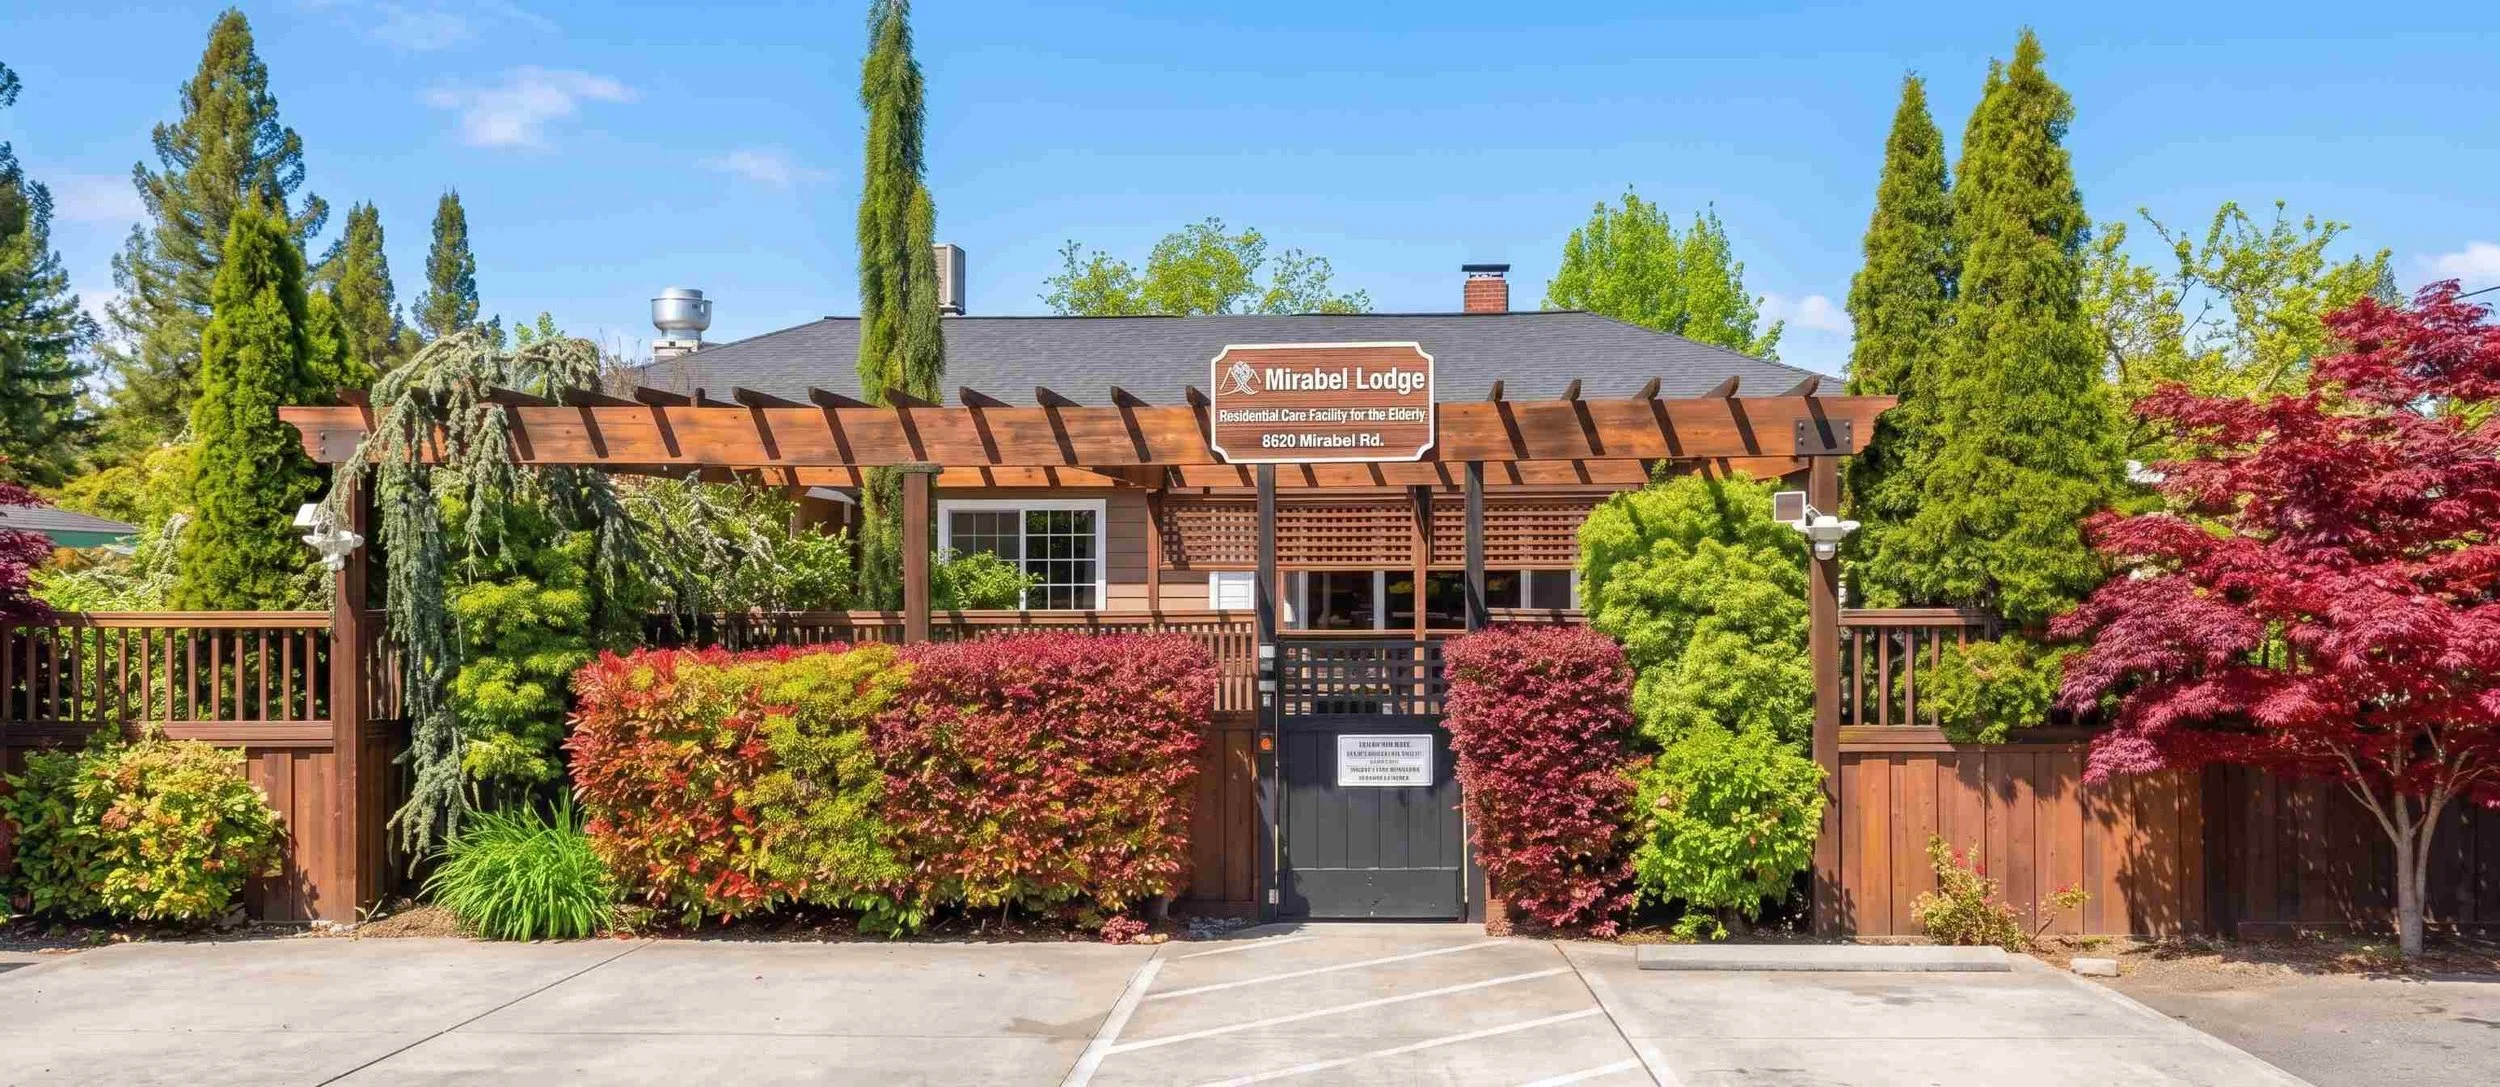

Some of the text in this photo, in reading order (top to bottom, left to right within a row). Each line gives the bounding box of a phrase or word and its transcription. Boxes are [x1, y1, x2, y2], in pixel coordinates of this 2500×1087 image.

[1265, 366, 1425, 395] Mirabel Lodge
[1219, 406, 1425, 424] Residential Care Facility for the Elderly
[1262, 432, 1385, 448] 8620 Mirabel Rd.
